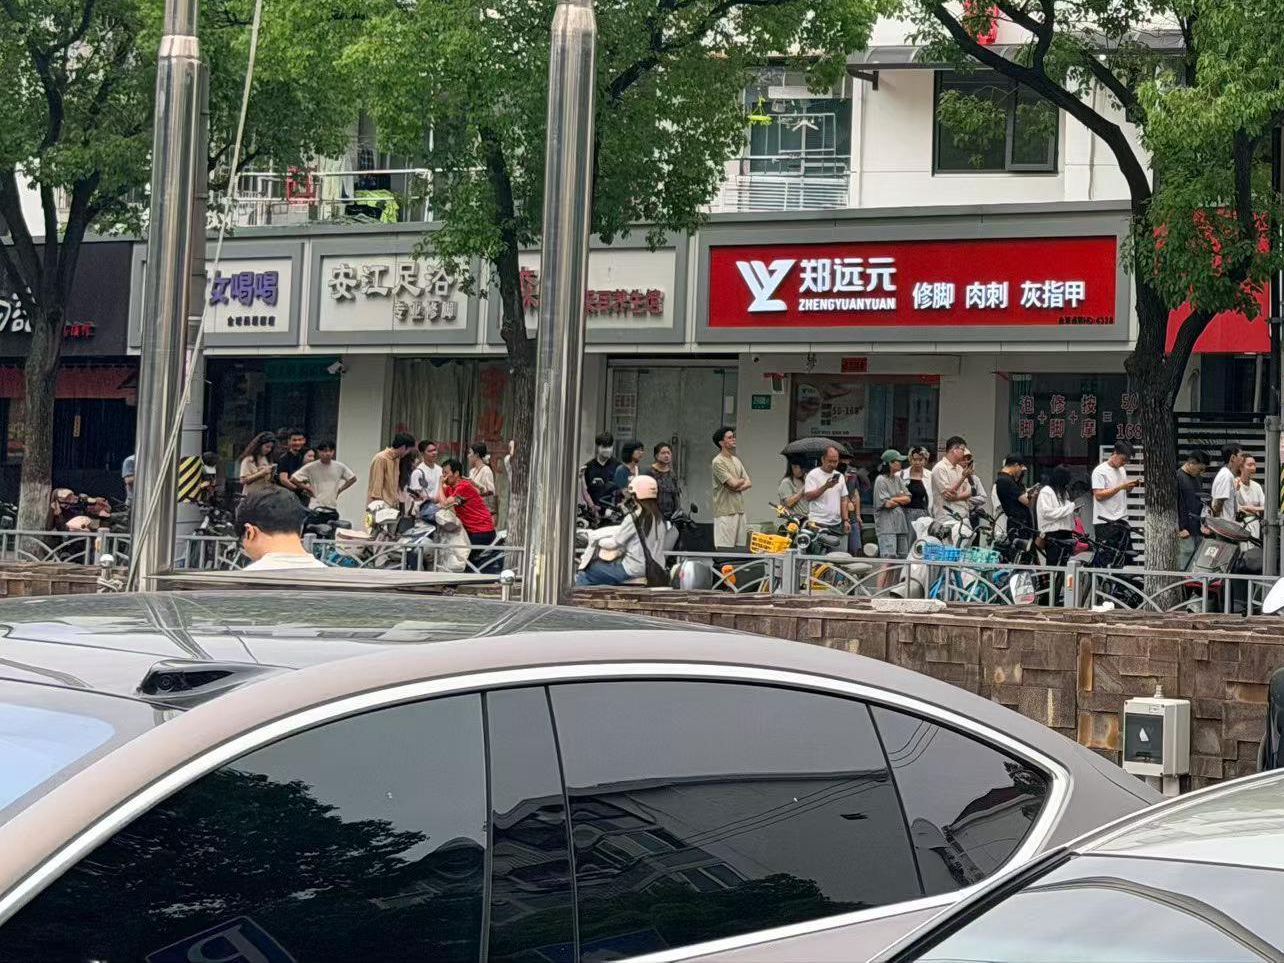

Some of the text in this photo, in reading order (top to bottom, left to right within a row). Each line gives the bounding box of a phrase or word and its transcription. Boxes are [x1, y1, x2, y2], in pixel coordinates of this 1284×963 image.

[328, 262, 455, 301] 安江足浴
[799, 257, 898, 293] 郑远元
[798, 297, 897, 312] ZHENGYUANYUAN
[912, 280, 1086, 310] 修脚 肉刺 灰指甲
